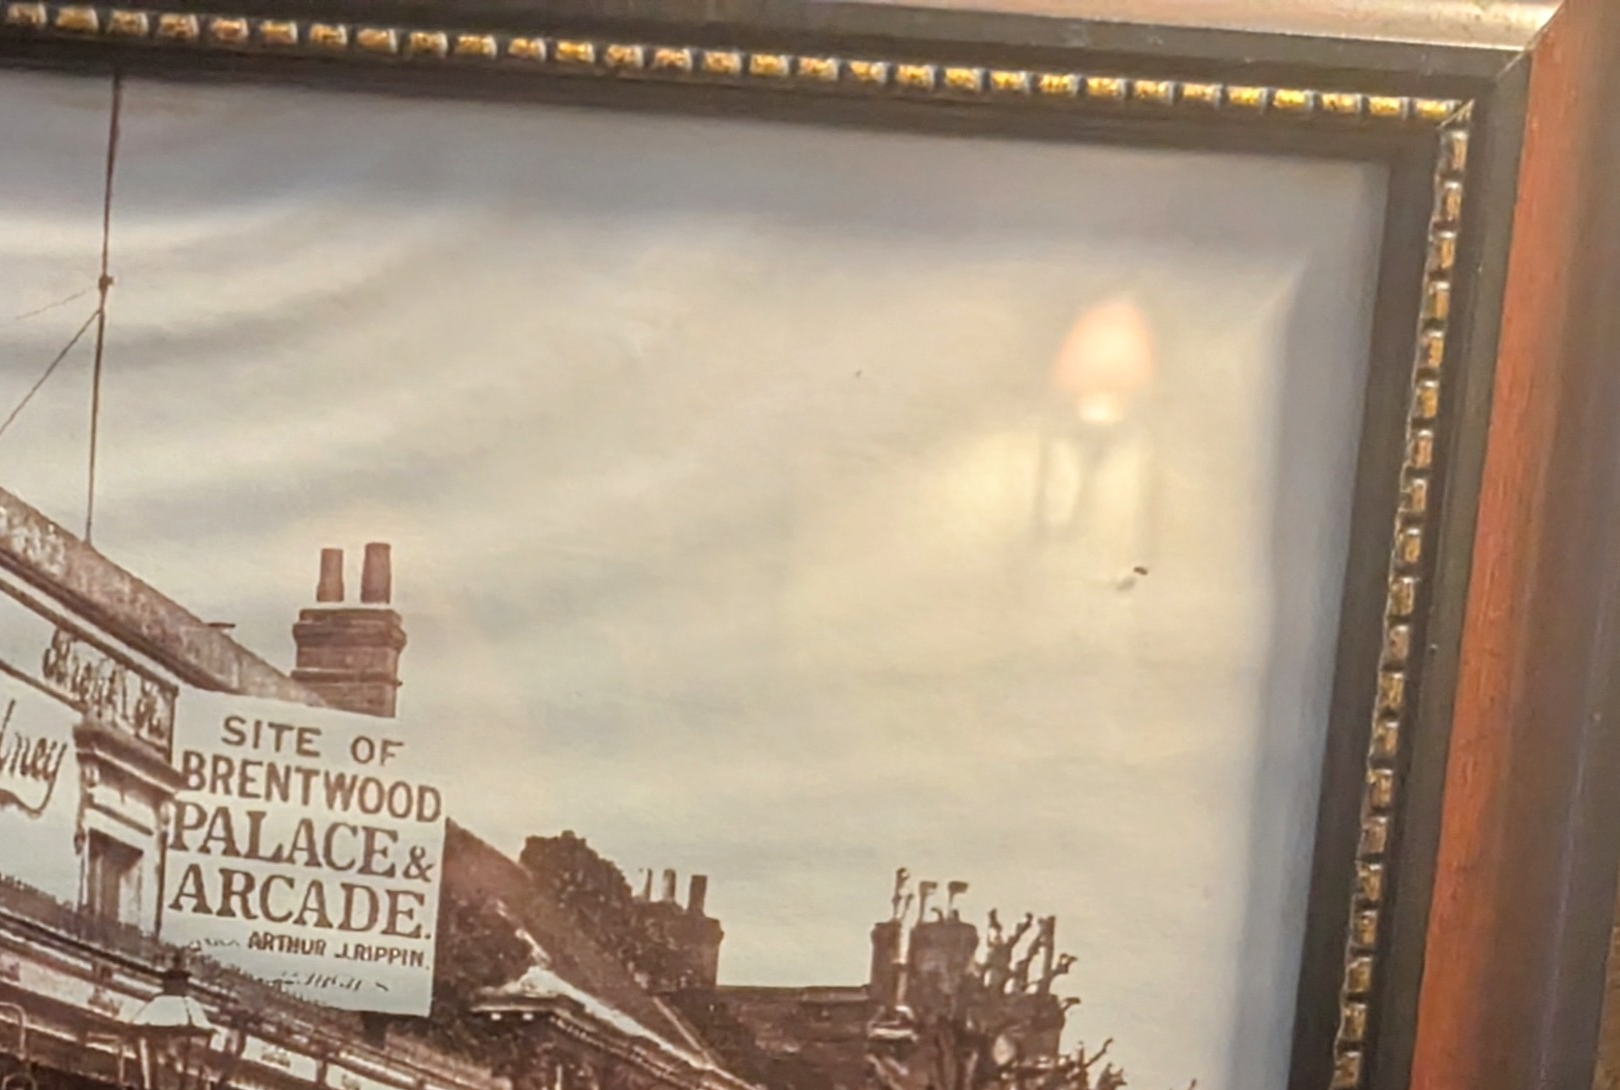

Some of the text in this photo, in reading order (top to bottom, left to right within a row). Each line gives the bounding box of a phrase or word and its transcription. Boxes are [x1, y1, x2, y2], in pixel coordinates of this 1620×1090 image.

[221, 714, 404, 767] SITE OF
[181, 749, 442, 824] BRENTWOOD
[168, 801, 399, 879] PALACE
[247, 930, 327, 957] ARTHUR
